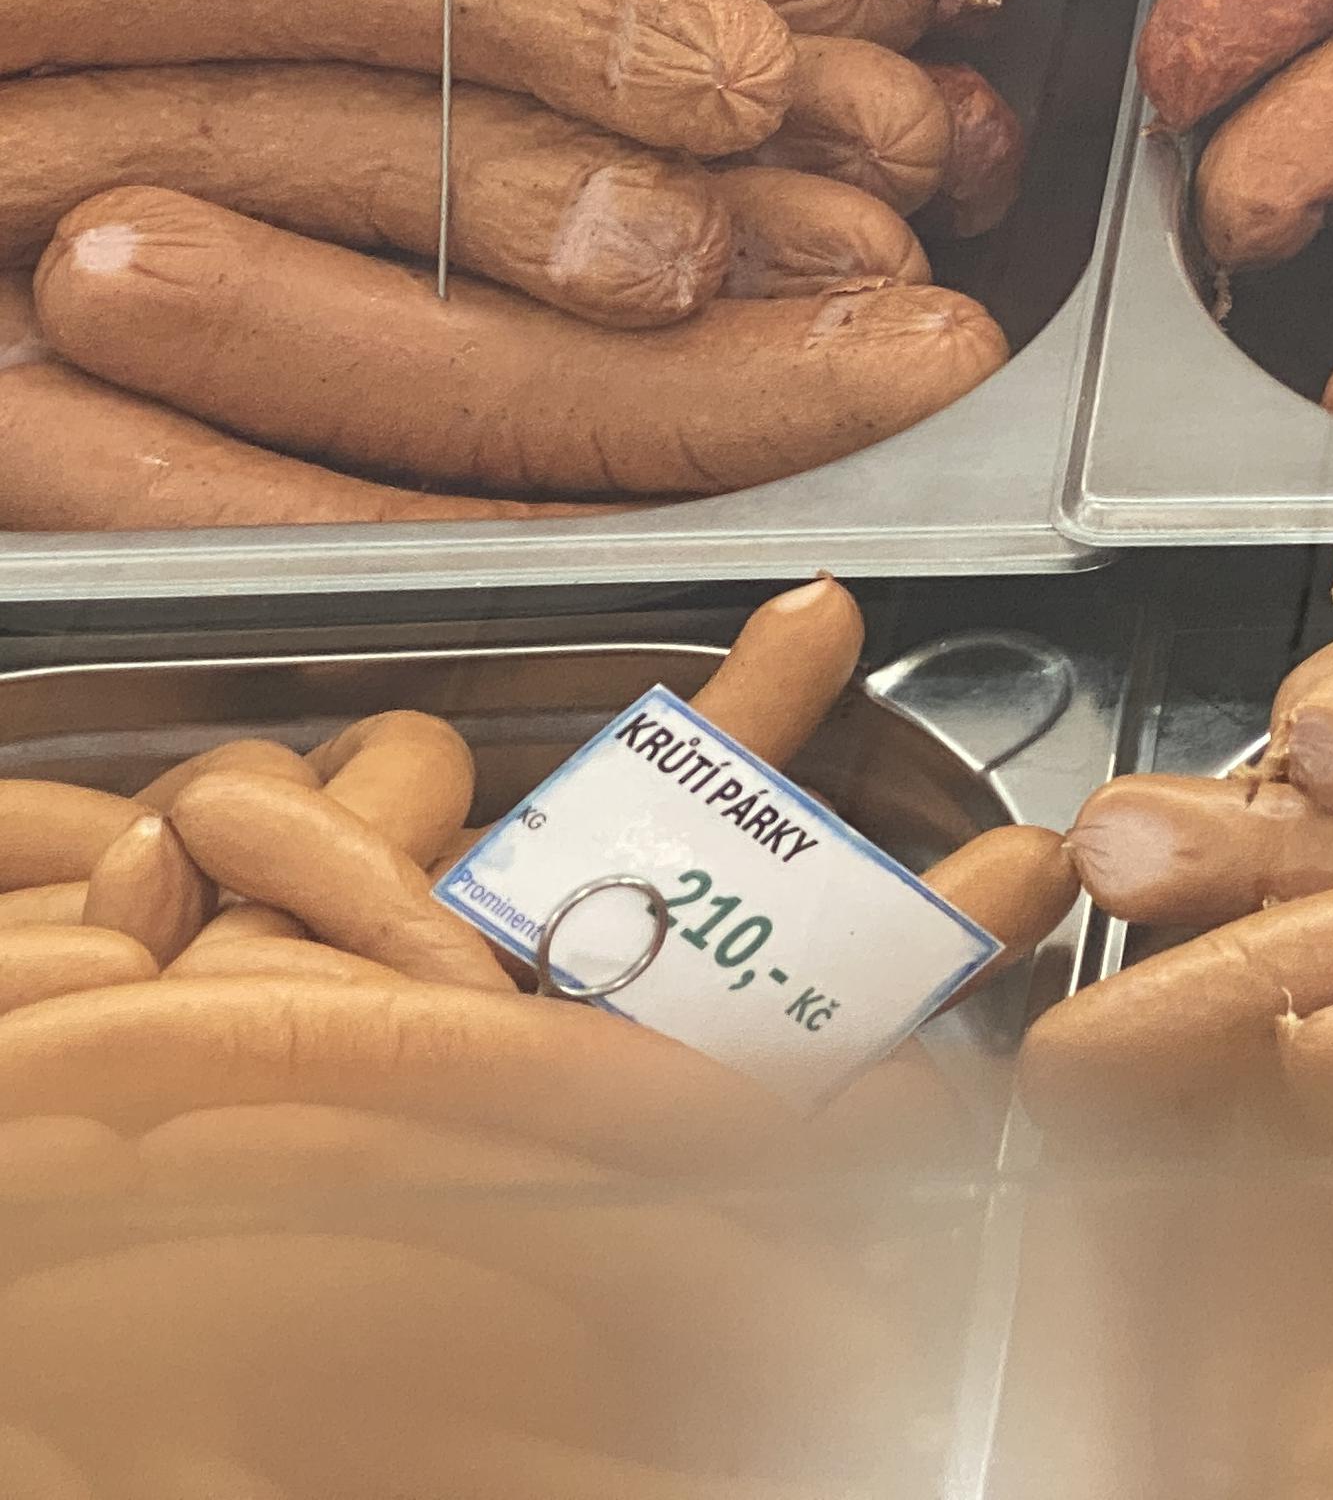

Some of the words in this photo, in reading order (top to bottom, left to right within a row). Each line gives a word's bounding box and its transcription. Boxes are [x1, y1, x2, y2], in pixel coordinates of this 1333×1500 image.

[517, 804, 548, 831] KG
[613, 712, 721, 794] KRŮTÍ
[705, 782, 820, 866] PÁRKY
[646, 868, 789, 992] 210,-
[785, 986, 842, 1033] Kč
